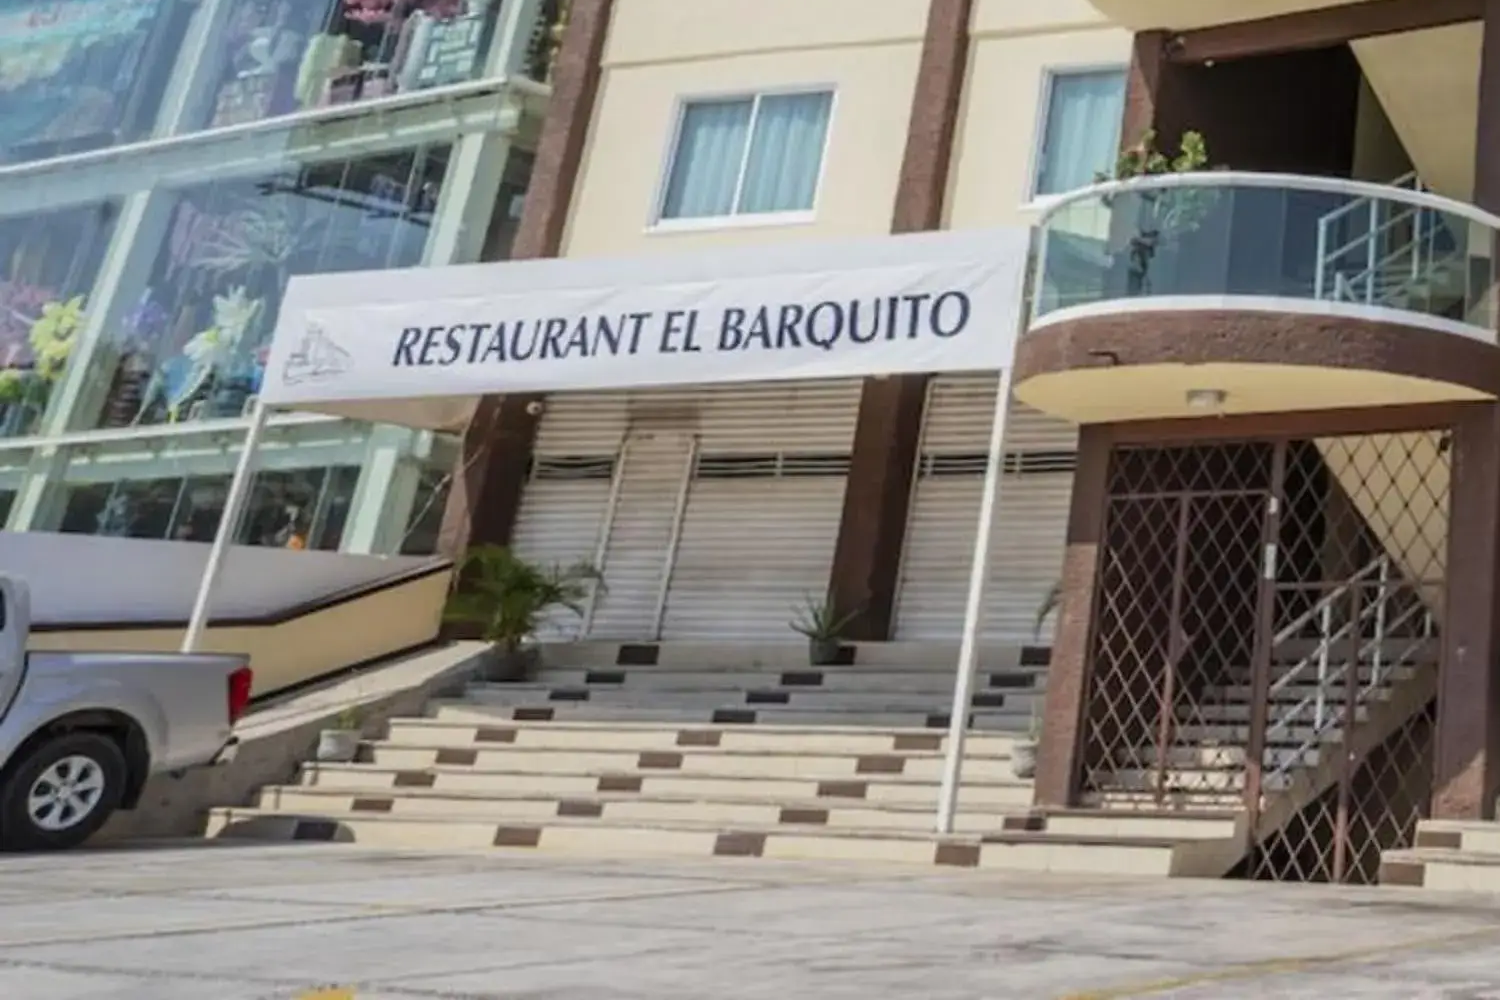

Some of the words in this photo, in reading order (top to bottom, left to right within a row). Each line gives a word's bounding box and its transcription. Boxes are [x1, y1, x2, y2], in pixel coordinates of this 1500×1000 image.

[392, 311, 653, 368] RESTAURANT
[657, 309, 703, 354] EL
[717, 290, 971, 352] BARQUITO
